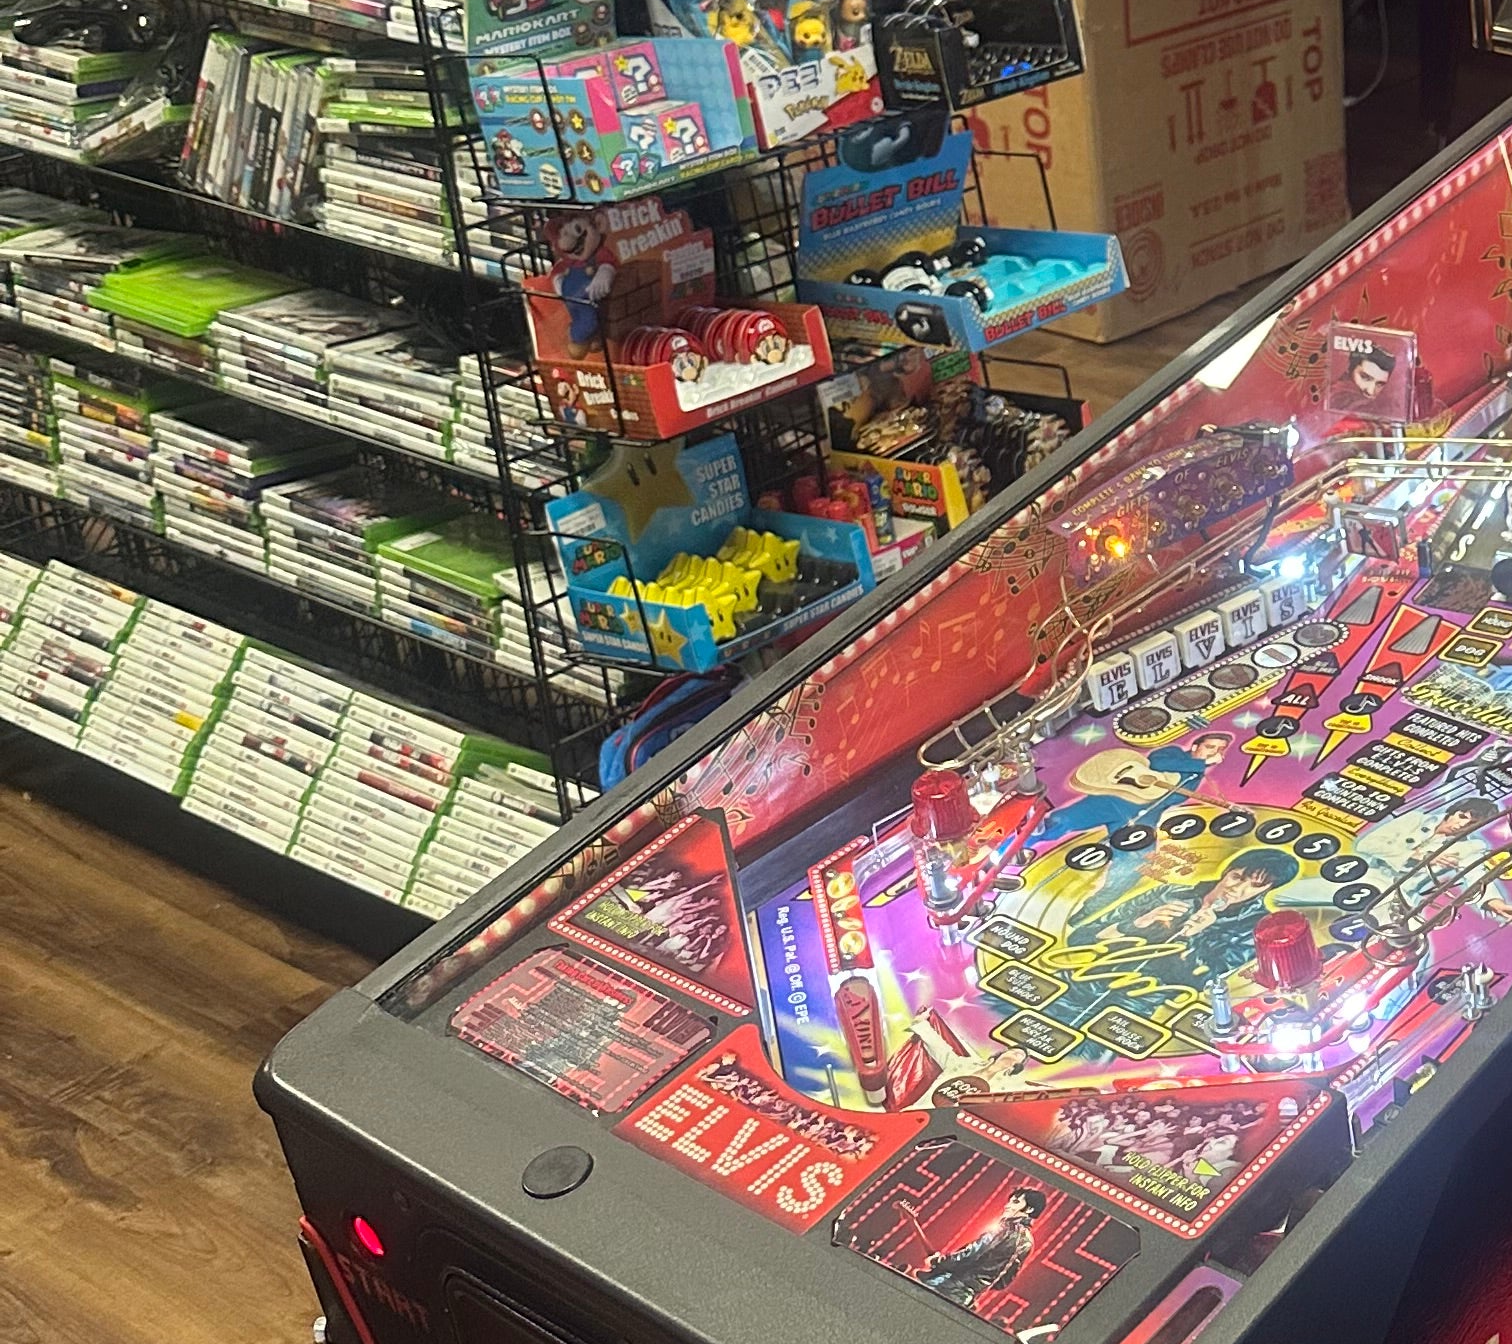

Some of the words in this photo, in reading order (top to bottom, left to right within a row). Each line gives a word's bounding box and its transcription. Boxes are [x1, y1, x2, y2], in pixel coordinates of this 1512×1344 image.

[475, 21, 532, 46] MARIO
[531, 8, 581, 30] KART
[551, 26, 573, 41] BOX
[890, 42, 936, 76] ZELDA
[1161, 38, 1217, 80] CLAMPS
[1302, 17, 1324, 103] TOP
[810, 184, 902, 233] BULLET
[905, 168, 960, 202] BILL
[608, 201, 659, 233] Brick
[616, 214, 683, 262] Breakin'
[985, 313, 1036, 344] BULLET
[1037, 298, 1067, 320] BILL
[1332, 335, 1374, 355] ELVIS
[577, 371, 606, 390] Brick
[696, 454, 738, 484] SUPER
[895, 467, 932, 484] SUPER
[1174, 468, 1191, 484] OF
[708, 473, 742, 502] STAR
[892, 479, 939, 500] MARIO
[1071, 487, 1116, 517] COMPLETE
[1123, 465, 1149, 486] BANK
[690, 492, 747, 527] CANDIES
[1272, 584, 1301, 604] ELVIS
[783, 614, 808, 634] SUPER
[807, 603, 829, 624] STAR
[829, 583, 866, 611] CANDIES
[1231, 599, 1261, 621] ELVIS
[1281, 598, 1296, 621] S
[1189, 618, 1220, 641] ELVIS
[1243, 617, 1255, 640] I
[1481, 613, 1512, 630] HOUND
[1146, 645, 1174, 667] ELVIS
[1196, 637, 1215, 660] V
[1454, 643, 1486, 657] DOG
[1101, 664, 1132, 686] ELVIS
[1151, 662, 1171, 684] L
[1364, 673, 1400, 687] SHOOK
[1110, 680, 1130, 707] E
[1281, 692, 1311, 707] ALL
[1402, 723, 1461, 749] COMPLETED
[1406, 711, 1459, 735] FEATURED
[1457, 727, 1484, 745] HITS
[1370, 743, 1409, 760] GIFTS
[1408, 755, 1441, 773] FROM
[1355, 756, 1421, 786] COMPLETED
[1333, 775, 1369, 793] TOP
[1370, 788, 1392, 802] 10
[1313, 789, 1379, 819] COMPLETED
[1178, 818, 1196, 836] 8
[1227, 814, 1242, 833] 7
[1271, 822, 1287, 840] 6
[1128, 828, 1141, 848] 9
[1310, 836, 1326, 855] 5
[1080, 843, 1099, 867] 10
[1335, 858, 1352, 878] 4
[1351, 887, 1364, 906] 3
[777, 905, 789, 922] Reg.
[780, 922, 793, 945] U.S.
[990, 924, 1030, 948] HOUND
[1347, 918, 1360, 936] 2
[785, 945, 798, 964] Pat.
[1002, 939, 1029, 958] DOG
[1006, 975, 1037, 994] SUEDE
[1007, 968, 1031, 983] BLUE
[1007, 985, 1042, 1004] SHOES
[795, 1004, 810, 1026] EPE
[1020, 1016, 1053, 1034] HEART
[1107, 1015, 1130, 1031] JAIL
[1021, 1026, 1053, 1043] BREAK
[1109, 1023, 1143, 1044] HOUSE
[1115, 1034, 1145, 1053] ROCK
[1027, 1036, 1057, 1054] HOTEL
[634, 1083, 845, 1220] ELVIS
[1121, 1150, 1153, 1170] HOLD
[1147, 1163, 1189, 1190] FLIPPER
[1185, 1181, 1211, 1200] FOR
[1128, 1172, 1175, 1200] INSTANT
[1169, 1192, 1198, 1212] INFO
[342, 1259, 429, 1334] START
